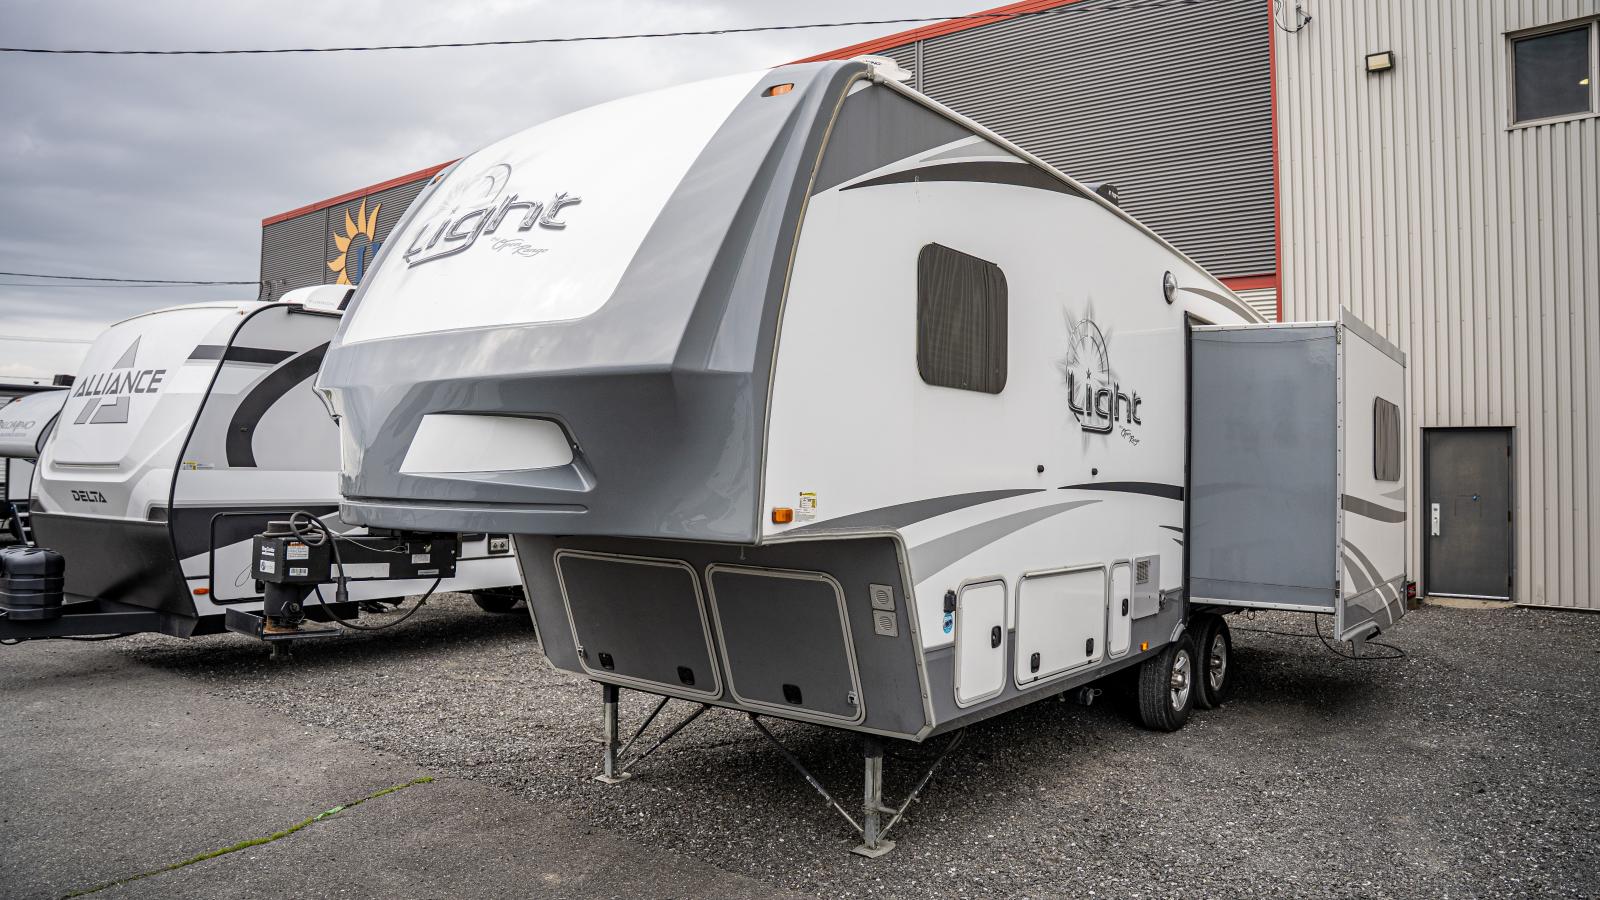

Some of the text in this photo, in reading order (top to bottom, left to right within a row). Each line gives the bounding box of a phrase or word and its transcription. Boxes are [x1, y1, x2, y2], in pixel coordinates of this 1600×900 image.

[403, 191, 582, 269] Light
[73, 369, 166, 397] ALLIANCE
[1067, 367, 1141, 435] Light
[71, 490, 108, 503] DELTA
